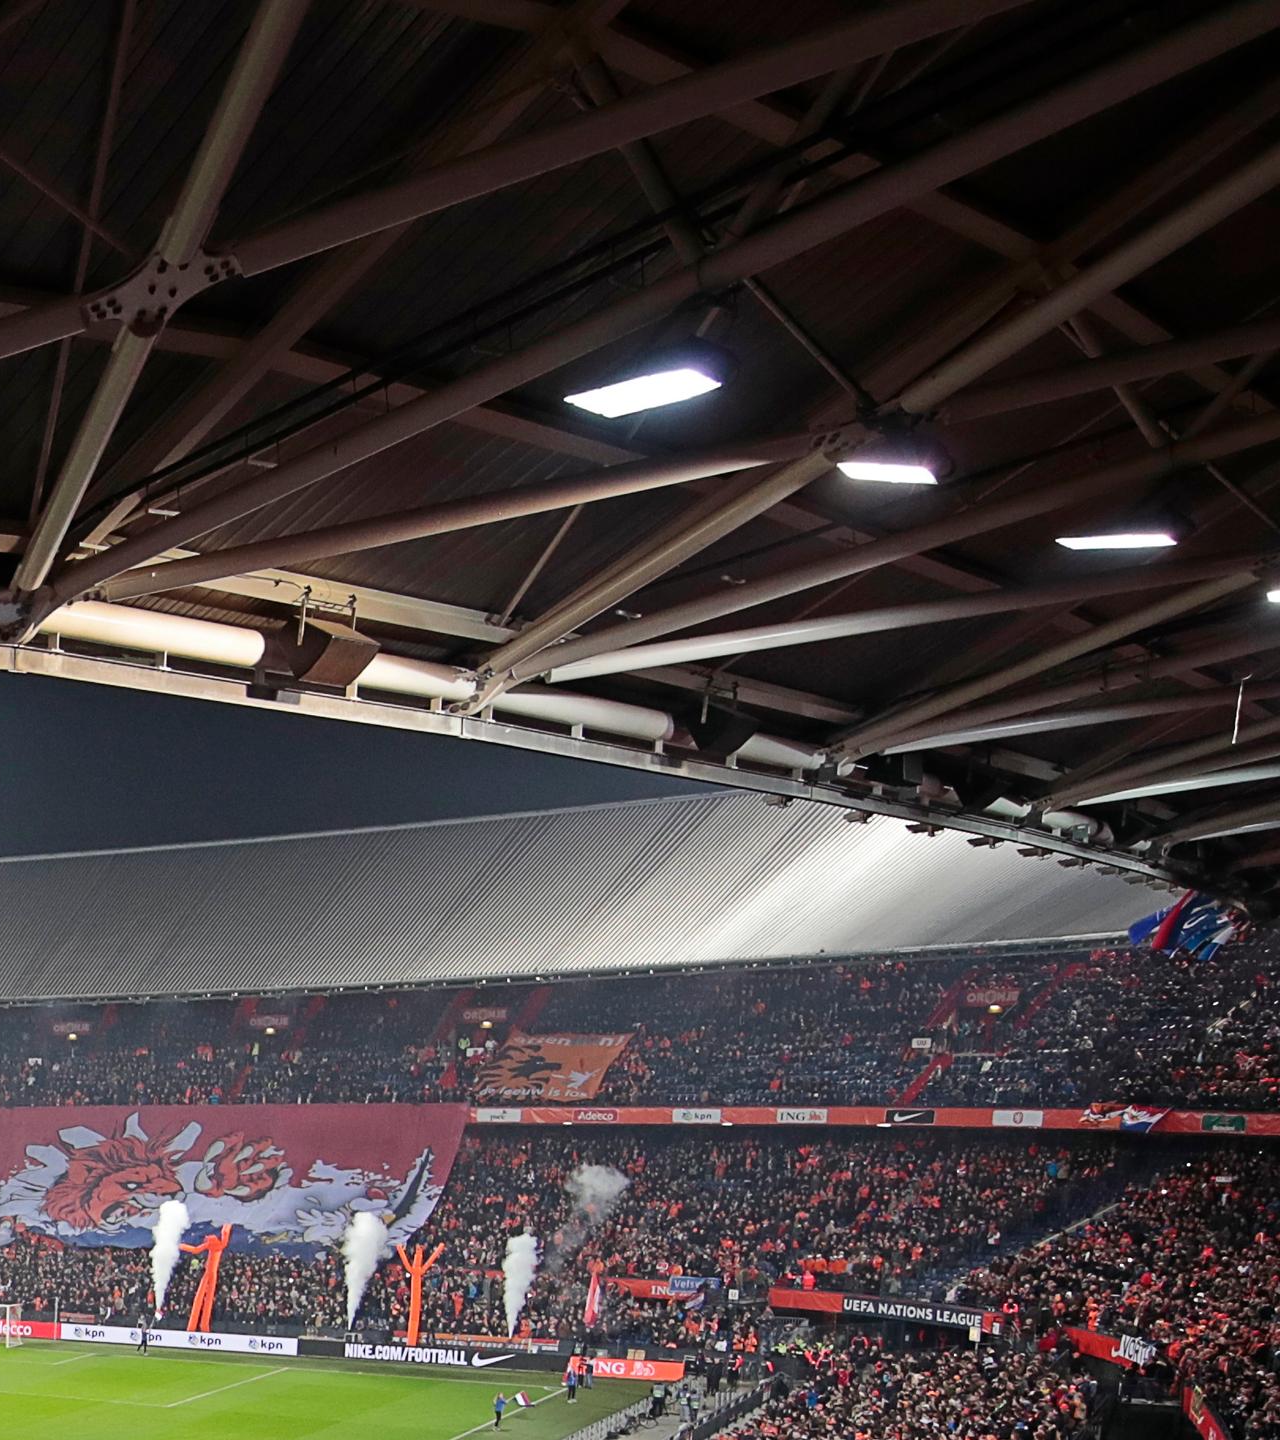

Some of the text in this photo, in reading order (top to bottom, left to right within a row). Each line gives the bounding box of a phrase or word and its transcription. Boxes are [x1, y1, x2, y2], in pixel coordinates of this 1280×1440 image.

[577, 1112, 614, 1121] Adecco
[694, 1112, 712, 1122] kpn
[780, 1112, 806, 1122] ING
[843, 1298, 982, 1327] UEFA NATIONS LEAGUE
[85, 1327, 105, 1339] kpn
[200, 1335, 221, 1347] kpn
[260, 1339, 283, 1351] kpn
[344, 1343, 468, 1366] NIKE.COM/FOOTBALL
